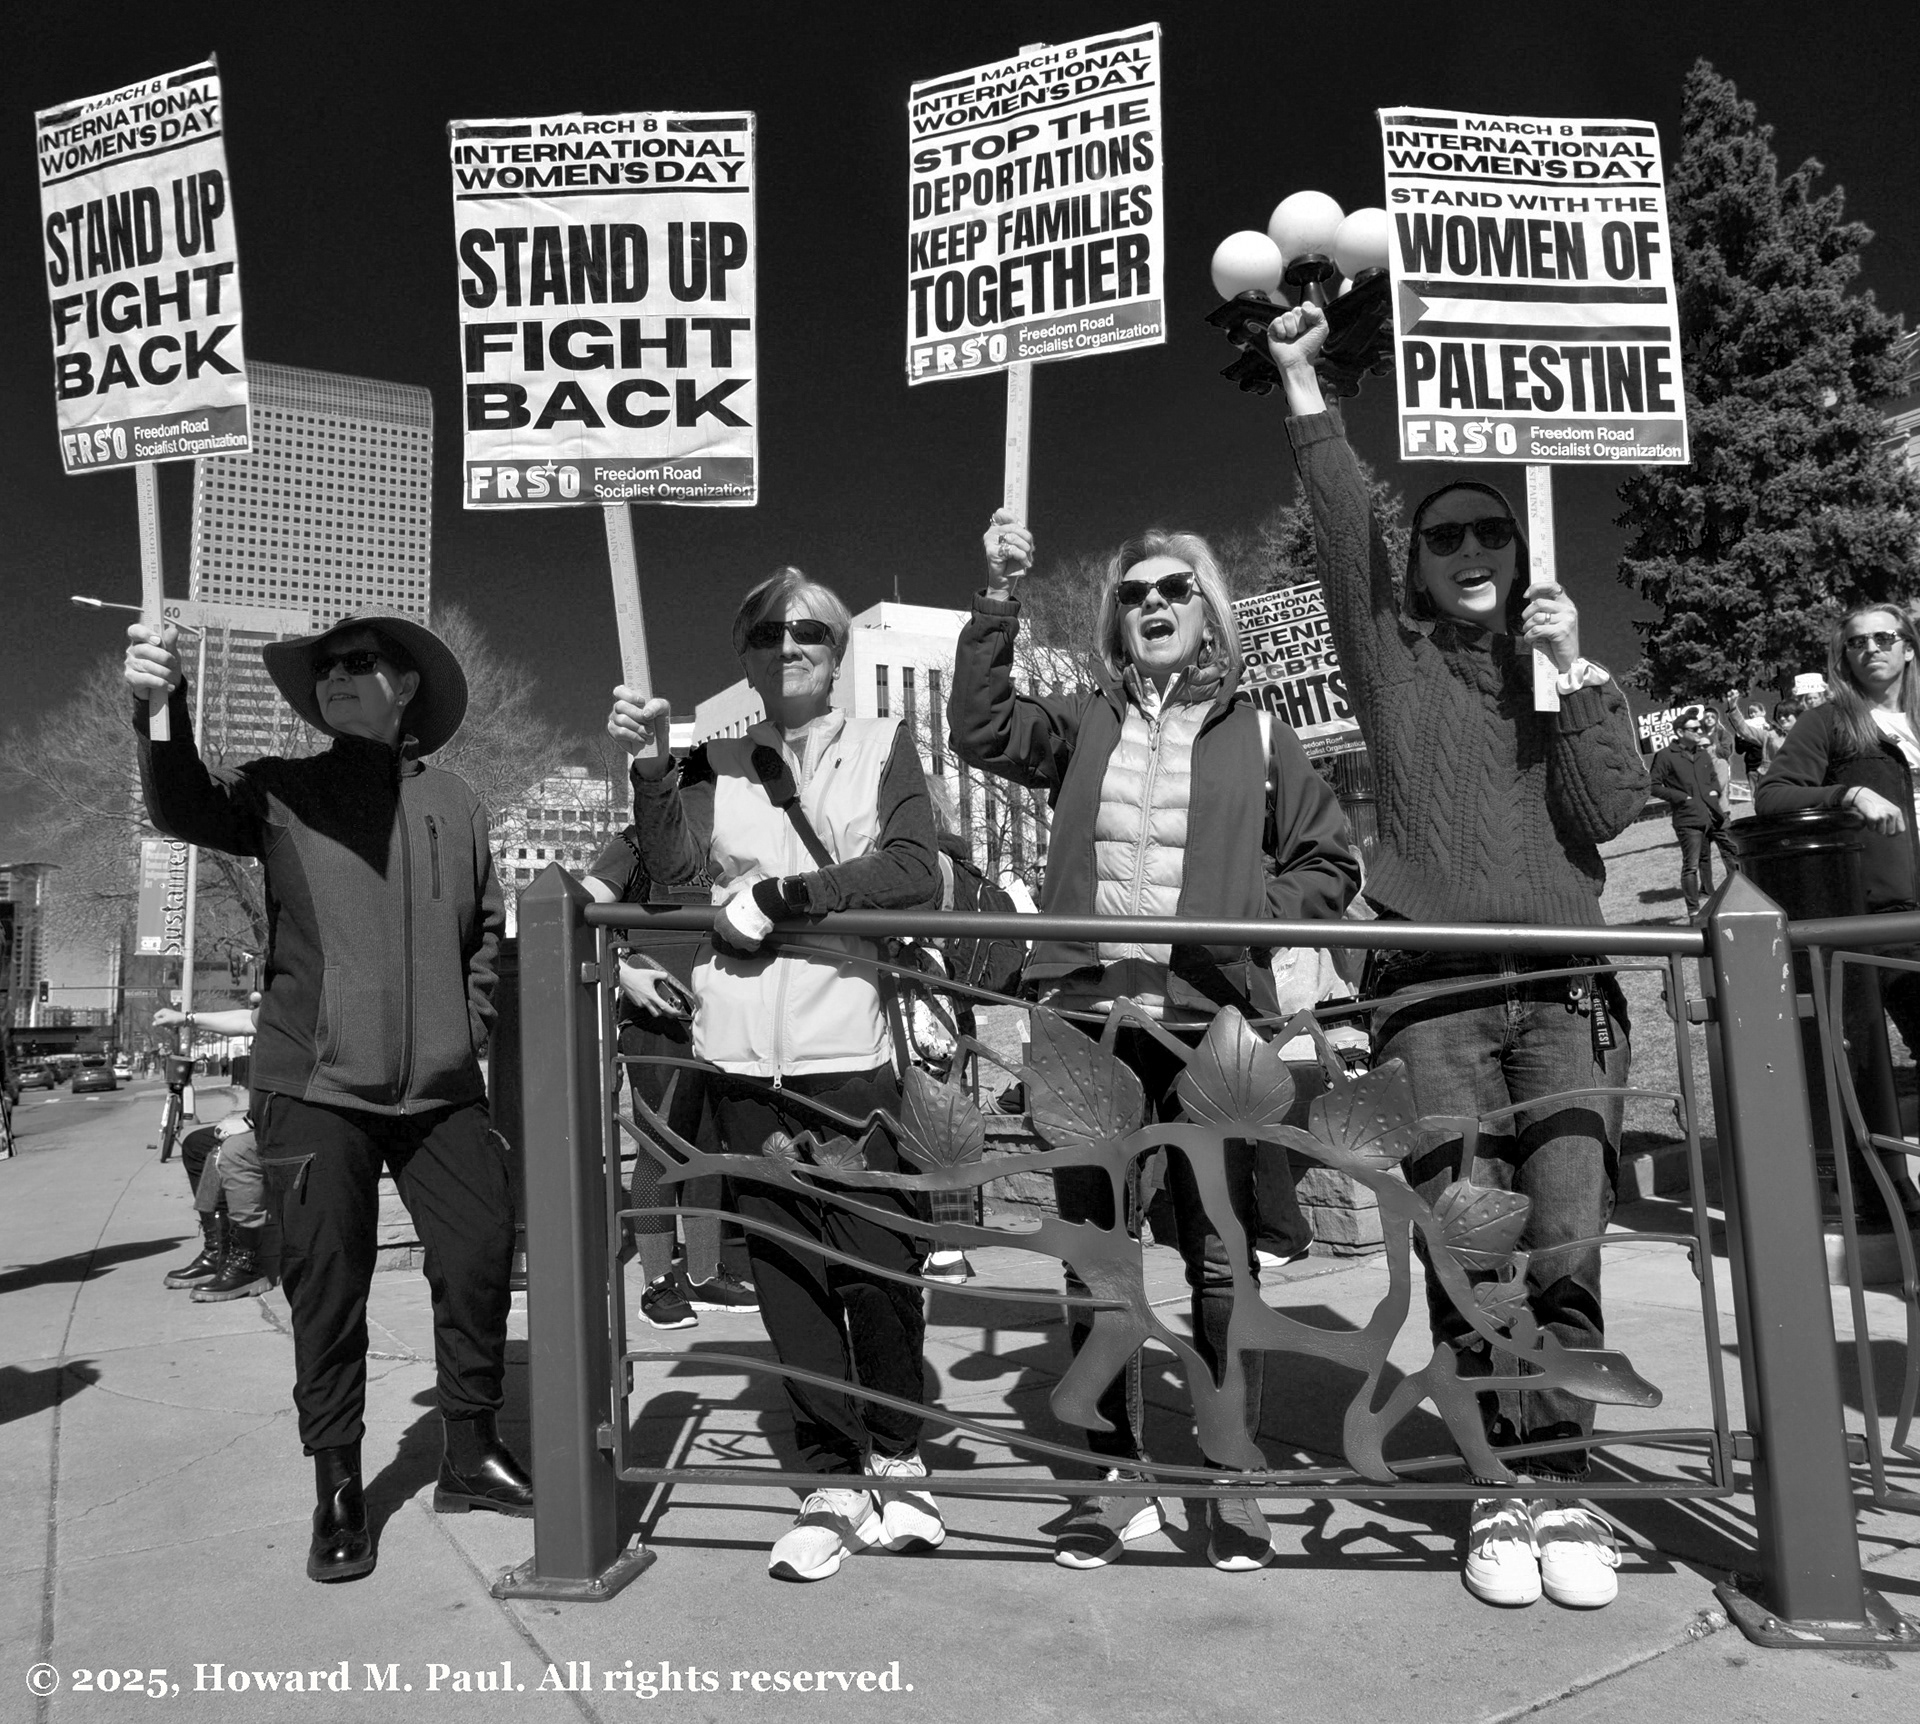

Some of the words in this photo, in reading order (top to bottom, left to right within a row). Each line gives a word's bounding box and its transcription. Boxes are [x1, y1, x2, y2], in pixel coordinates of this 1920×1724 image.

[913, 47, 1151, 117] INTERNATIONAL
[981, 54, 1060, 83] MARCH
[1066, 48, 1077, 60] 8
[86, 85, 146, 113] MARCH
[151, 80, 162, 94] 8
[913, 83, 1070, 135] WOMEN'S
[1075, 62, 1151, 94] DAY
[38, 84, 218, 153] INTERNATIONAL
[540, 120, 636, 137] MARCH
[643, 119, 658, 132] 8
[1465, 119, 1553, 136] MARCH
[1559, 125, 1574, 136] 8
[42, 125, 157, 176] WOMEN'S
[161, 106, 219, 142] DAY
[454, 138, 745, 165] INTERNATIONAL
[913, 124, 1039, 174] STOP
[1048, 98, 1151, 141] THE
[1386, 131, 1654, 158] INTERNATIONAL
[455, 162, 649, 190] WOMEN'S
[655, 161, 746, 183] DAY
[913, 130, 1154, 221] DEPORTATIONS
[1387, 150, 1568, 179] WOMEN'S
[1573, 160, 1656, 179] DAY
[1391, 187, 1503, 208] STAND
[1508, 194, 1590, 213] WITH
[1595, 197, 1658, 213] THE
[46, 185, 163, 288] STAND
[172, 169, 225, 258] UP
[910, 219, 987, 273] KEEP
[998, 184, 1153, 256] FAMILIES
[1395, 212, 1589, 281] WOMEN
[1601, 220, 1661, 281] OF
[459, 223, 649, 309] STAND
[667, 221, 748, 302] UP
[910, 233, 1151, 339] TOGETHER
[52, 261, 234, 347] FIGHT
[1018, 337, 1074, 357] Socialist
[1076, 321, 1160, 349] Organization
[1019, 321, 1077, 343] Freedom
[1079, 313, 1115, 331] Road
[465, 318, 750, 373] FIGHT
[913, 333, 1008, 376] FRSO
[56, 324, 242, 401] BACK
[1402, 340, 1676, 414] PALESTINE
[467, 379, 753, 431] BACK
[63, 425, 127, 466] FRSO
[134, 423, 179, 440] Freedom
[181, 418, 209, 434] Road
[135, 440, 178, 458] Socialist
[179, 433, 247, 454] Organization
[1406, 419, 1518, 455] FRSO
[1531, 426, 1594, 441] Freedom
[1597, 427, 1634, 441] Road
[1531, 442, 1591, 457] Socialist
[1594, 443, 1682, 460] Organization
[470, 463, 581, 499] FRSO
[594, 467, 659, 481] Freedom
[663, 466, 702, 480] Road
[594, 483, 655, 498] Socialist
[657, 483, 752, 500] Organization
[164, 607, 181, 619] 60
[1239, 594, 1281, 608] MARCH
[1237, 610, 1291, 630] MEN'S
[1241, 619, 1330, 653] EFEND
[1245, 636, 1334, 667] OMEN'S
[1235, 670, 1355, 729] IGHTS
[1638, 711, 1661, 726] WE
[1639, 722, 1673, 739] BLEED
[1302, 741, 1325, 750] eedom
[1326, 735, 1344, 746] Road
[1306, 747, 1326, 756] cialist
[1326, 740, 1366, 753] Organization
[157, 839, 188, 955] Sustained
[1593, 998, 1606, 1026] BEFORE
[1597, 1028, 1610, 1046] TEST
